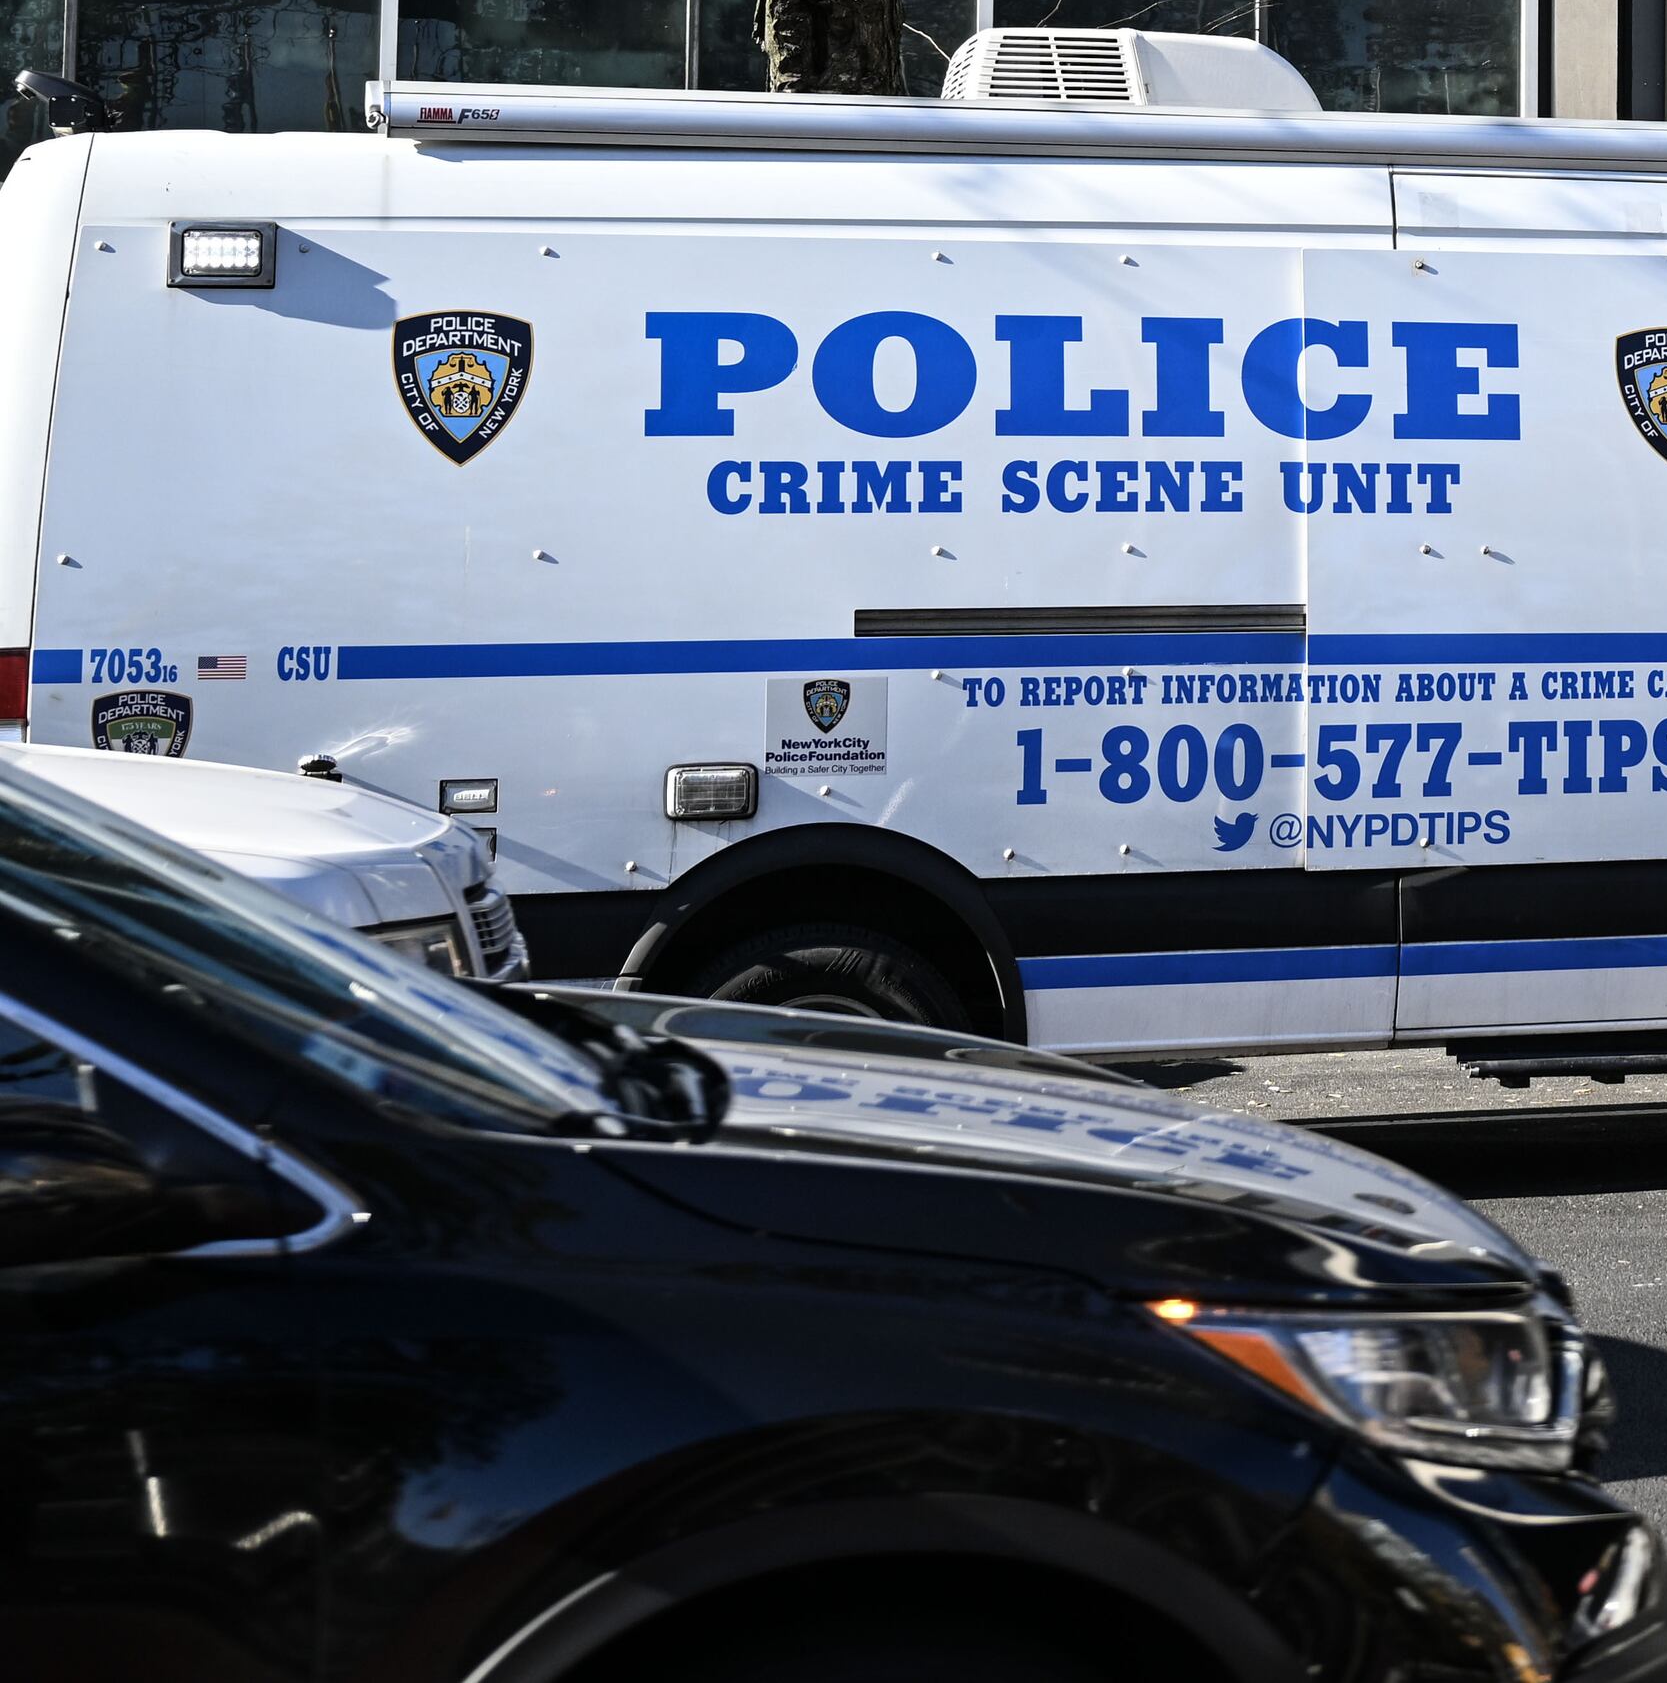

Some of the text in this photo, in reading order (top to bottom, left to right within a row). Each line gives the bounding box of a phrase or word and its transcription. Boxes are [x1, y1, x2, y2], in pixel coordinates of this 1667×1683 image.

[420, 107, 453, 120] FIAMMA
[430, 316, 496, 333] POLICE
[402, 331, 522, 357] DEPARTMENT
[643, 310, 1521, 442] POLICE
[401, 372, 439, 432] CITY OF
[478, 367, 524, 439] NEW YORK
[1624, 384, 1659, 439] CITY OF
[706, 459, 1461, 515] CRIME SCENE UNIT
[276, 645, 332, 681] CSU
[118, 693, 166, 706] POLICE
[806, 686, 848, 696] DEPARTMENT
[962, 677, 1006, 707] TO
[1019, 675, 1148, 707] REPORT
[1161, 673, 1382, 705] INFORMATION
[1395, 672, 1496, 702] ABOUT
[1508, 671, 1529, 701] A
[1541, 669, 1634, 700] CRIME
[98, 704, 185, 724] DEPARTMENT
[169, 729, 186, 756] YORK
[765, 763, 885, 775] Building a Safer City Together
[1269, 809, 1511, 849] @NYPDTIPS
